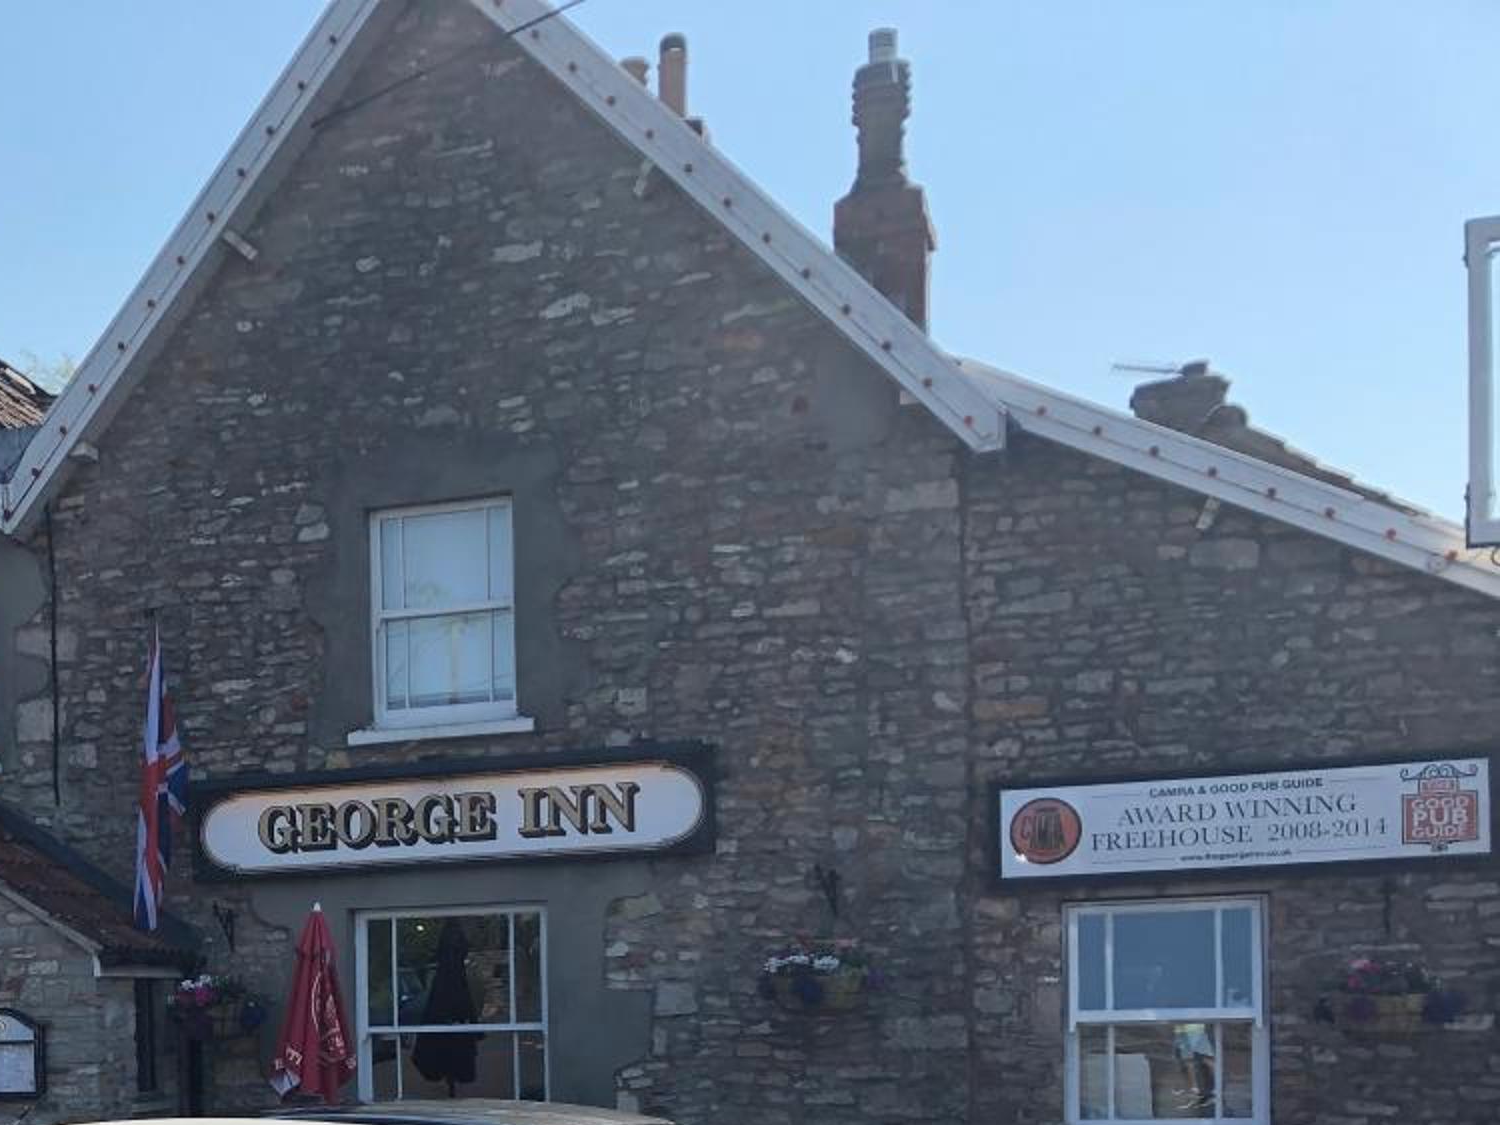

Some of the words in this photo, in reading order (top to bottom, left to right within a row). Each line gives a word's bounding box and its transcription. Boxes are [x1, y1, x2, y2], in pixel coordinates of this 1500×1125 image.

[1150, 785, 1195, 798] CAMRA
[1198, 785, 1207, 795] &
[1210, 782, 1249, 795] GOOD
[1252, 779, 1279, 791] PUB
[1283, 777, 1323, 789] GUIDE
[1118, 802, 1218, 827] AWARD
[1225, 793, 1356, 819] WINNING
[1411, 796, 1469, 810] GOOD
[258, 791, 496, 853] GEORGE
[518, 782, 641, 838] INN
[1412, 808, 1468, 826] PUB
[1092, 825, 1253, 851] FREEHOUSE
[1267, 817, 1388, 843] 2008-2014
[1412, 824, 1469, 839] GUIDE
